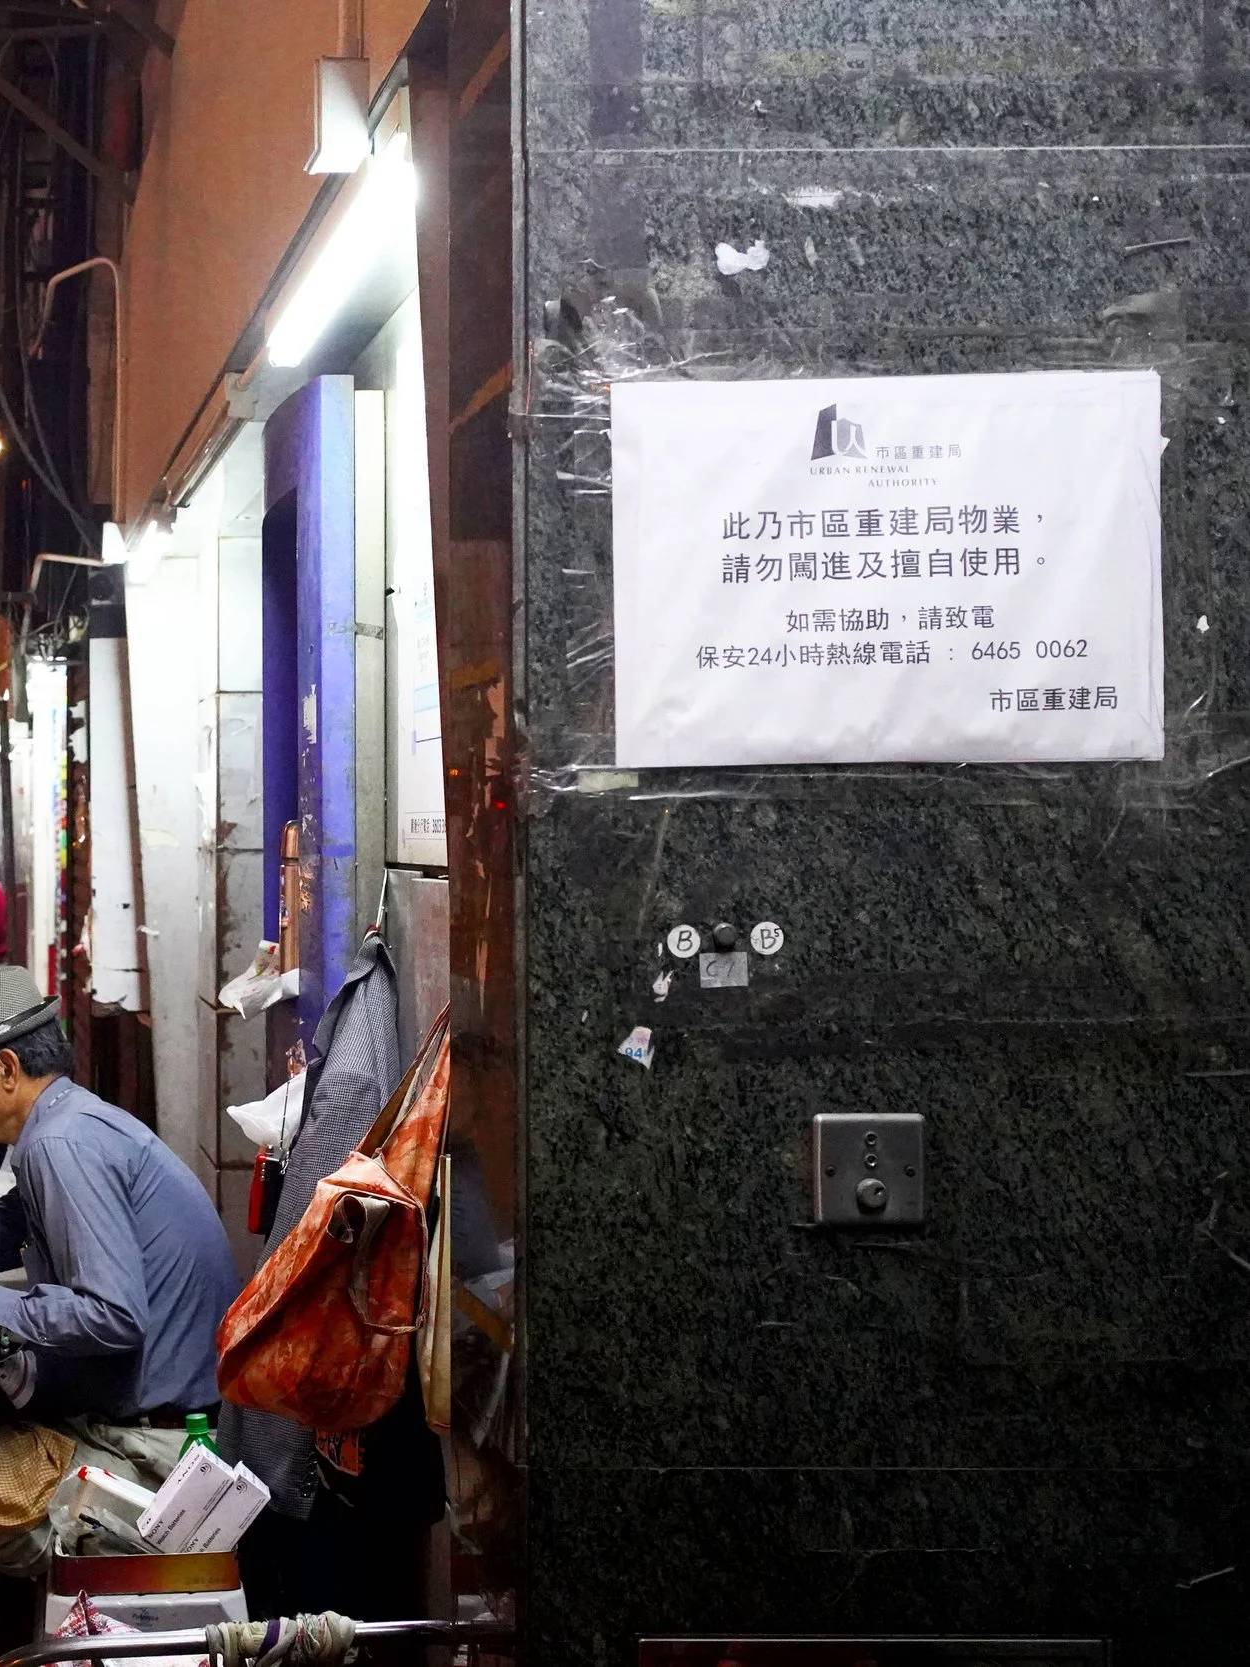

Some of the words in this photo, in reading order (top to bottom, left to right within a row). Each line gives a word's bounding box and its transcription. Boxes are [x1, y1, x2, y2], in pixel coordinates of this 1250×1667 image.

[875, 443, 962, 460] 市區重建局
[810, 467, 850, 475] URBAN
[855, 465, 910, 474] RENEWAL
[868, 478, 938, 487] AUTHORITY
[785, 604, 996, 633] 如需協助，請致電
[970, 641, 1022, 661] 6465
[1035, 638, 1089, 660] 0062
[990, 686, 1118, 713] 市區重建局
[676, 930, 693, 952] B
[148, 1519, 164, 1539] SONY
[156, 1529, 170, 1545] Watch
[168, 1509, 186, 1531] Batteries
[203, 1527, 222, 1549] Batteries
[185, 1537, 200, 1553] ONY
